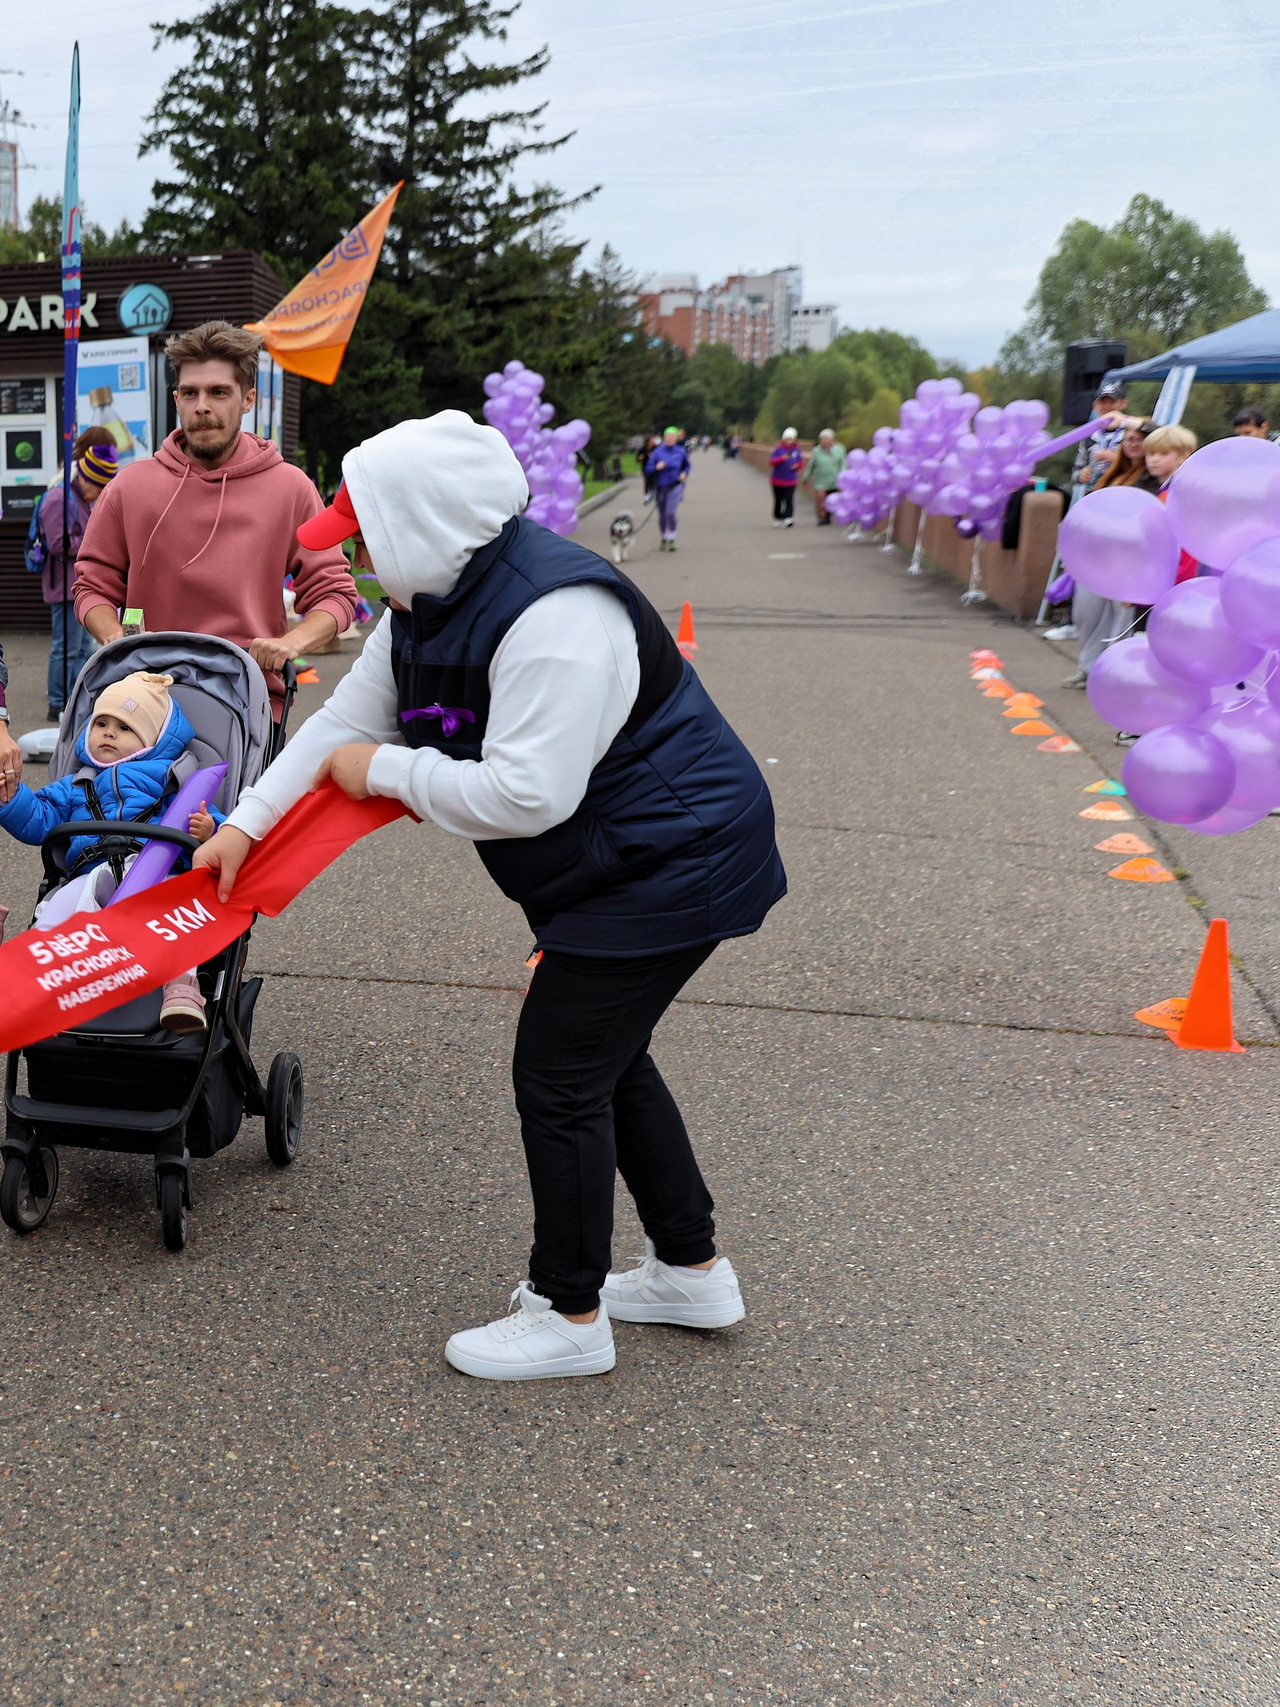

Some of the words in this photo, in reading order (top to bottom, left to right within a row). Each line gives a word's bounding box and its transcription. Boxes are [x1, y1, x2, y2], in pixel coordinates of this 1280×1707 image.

[145, 919, 178, 941] 5
[163, 898, 217, 934] КМ
[28, 941, 54, 965] 5
[57, 963, 148, 1011] НАБЕРЕЖНАЯ
